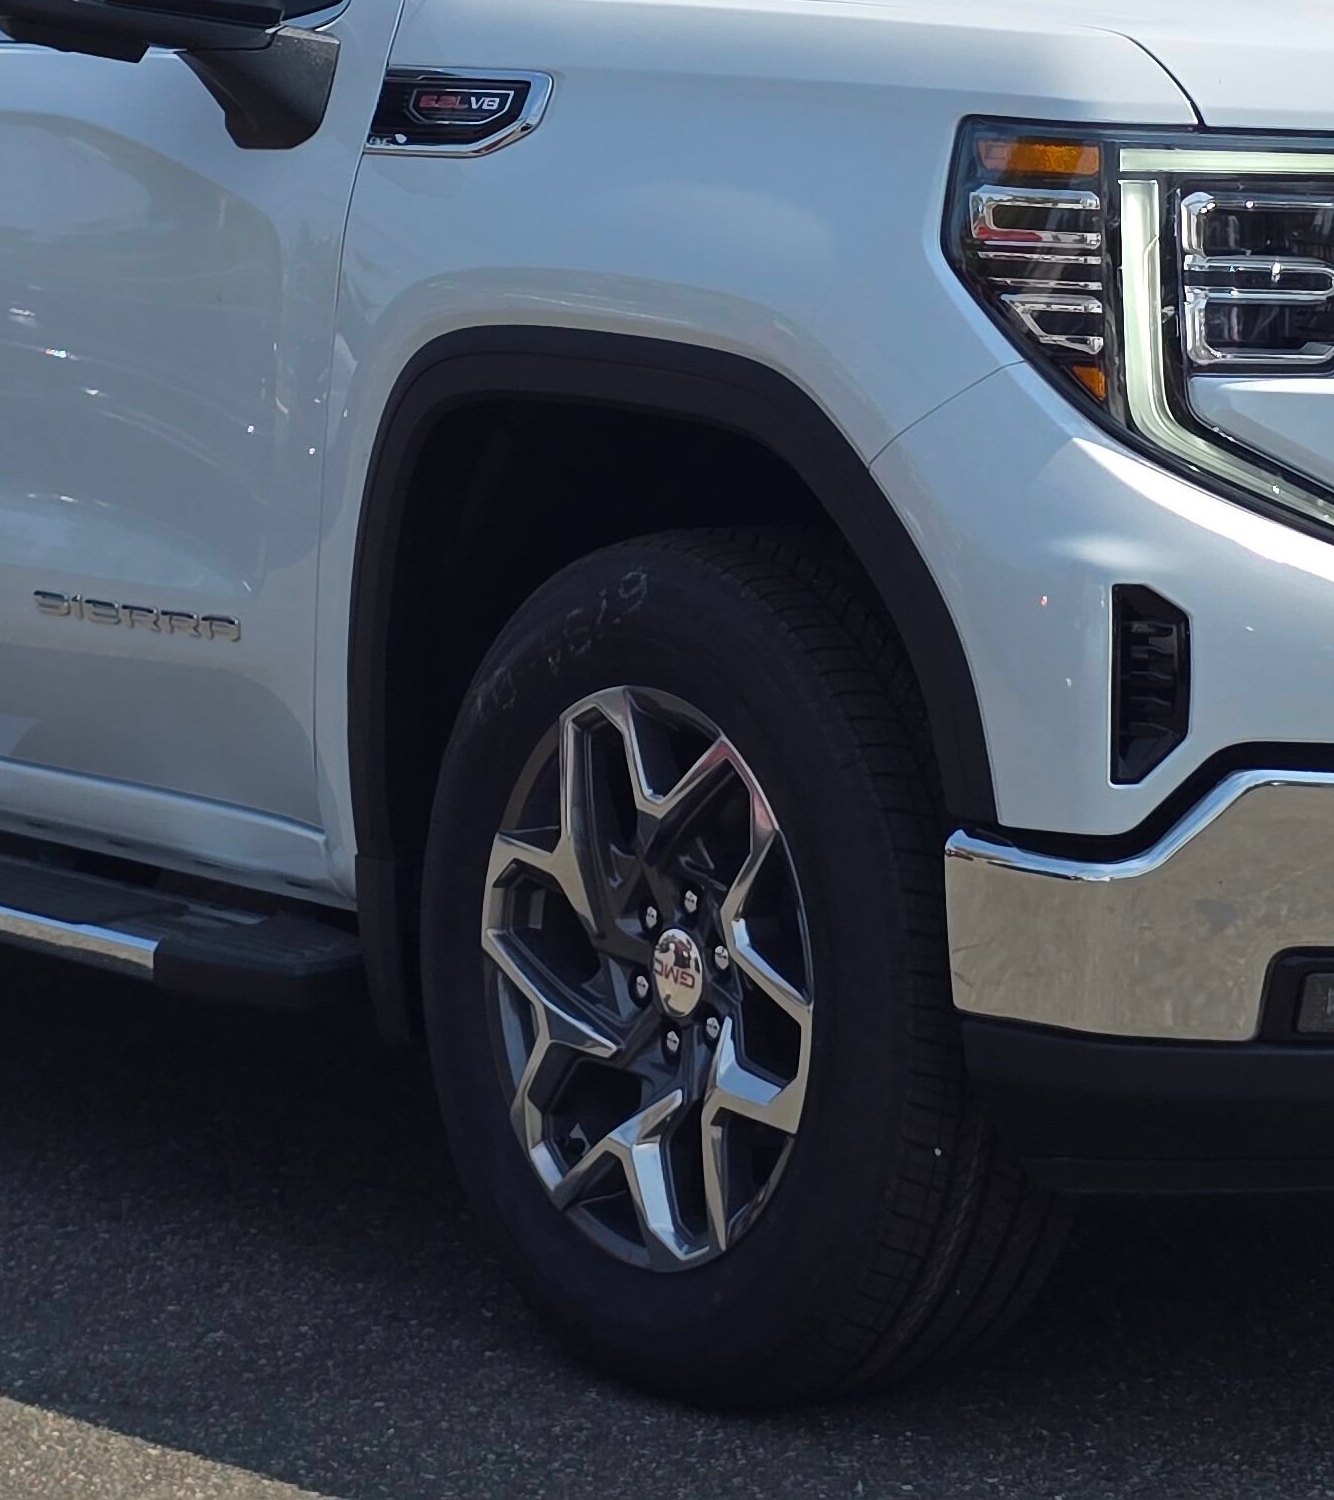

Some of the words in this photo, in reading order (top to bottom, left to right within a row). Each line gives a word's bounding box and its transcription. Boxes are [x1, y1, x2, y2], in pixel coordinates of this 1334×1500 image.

[469, 96, 500, 110] V8
[32, 589, 243, 643] SIERRA
[653, 957, 696, 989] GMC
